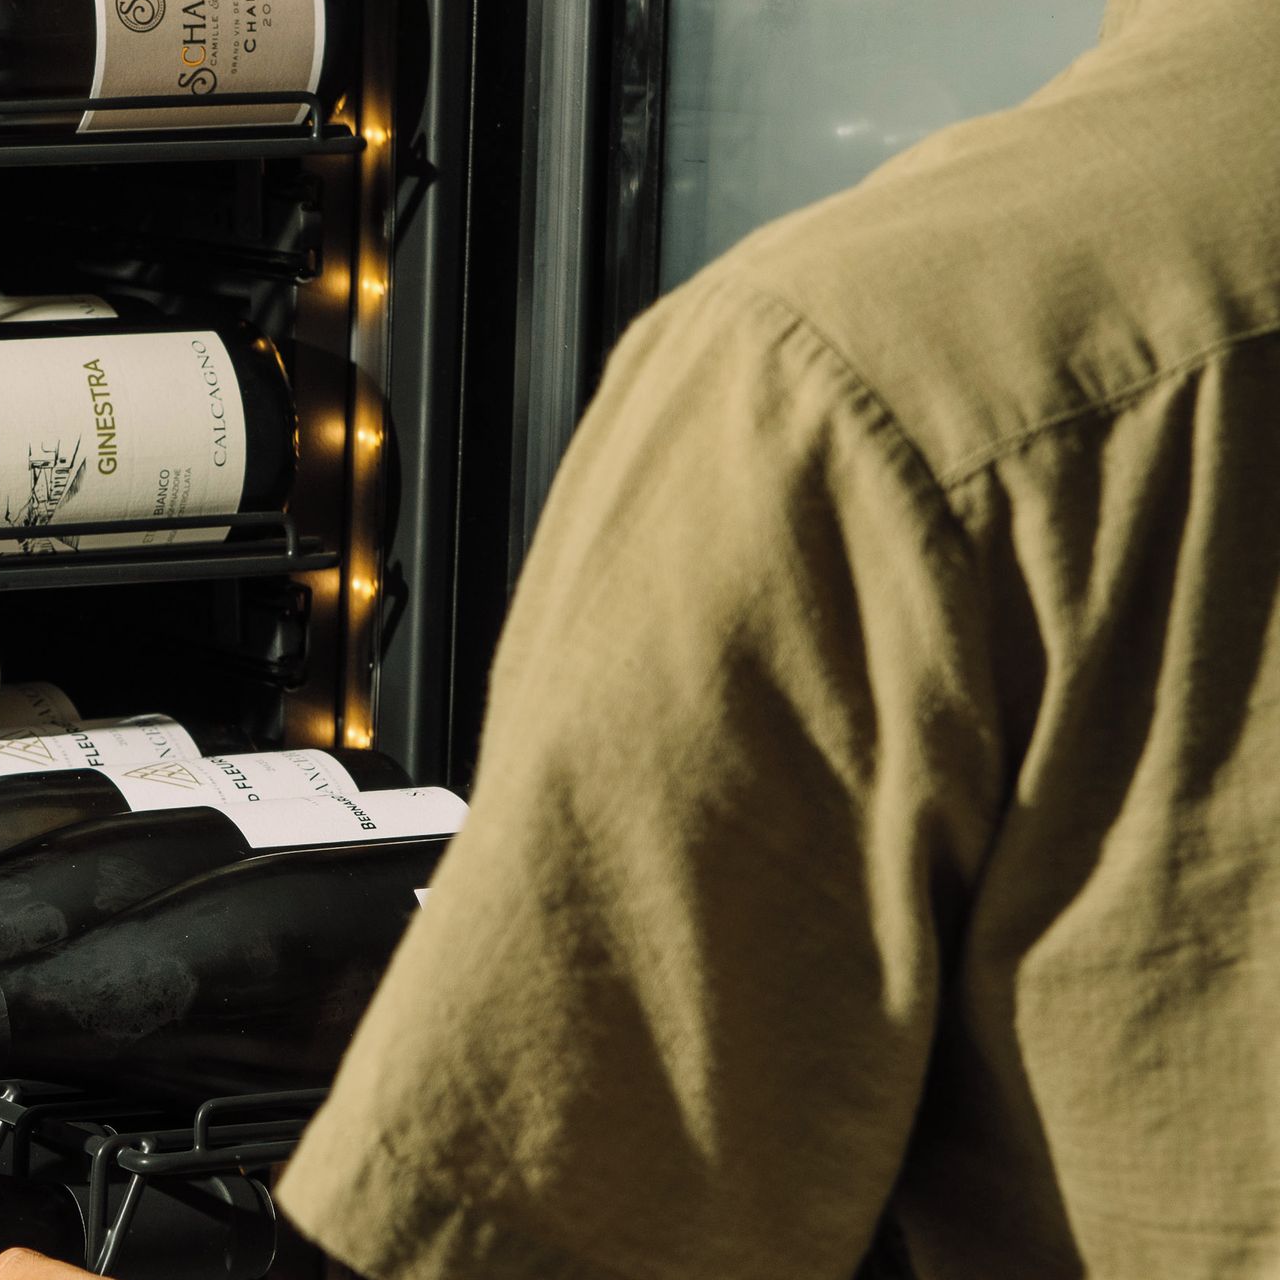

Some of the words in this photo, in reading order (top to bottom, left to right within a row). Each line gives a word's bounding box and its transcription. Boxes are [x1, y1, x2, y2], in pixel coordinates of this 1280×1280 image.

[233, 1, 239, 14] DE
[210, 15, 219, 67] CAMILLE
[83, 358, 117, 475] GINESTRA
[192, 340, 227, 467] CALCAGNO
[153, 469, 170, 516] BIANCO
